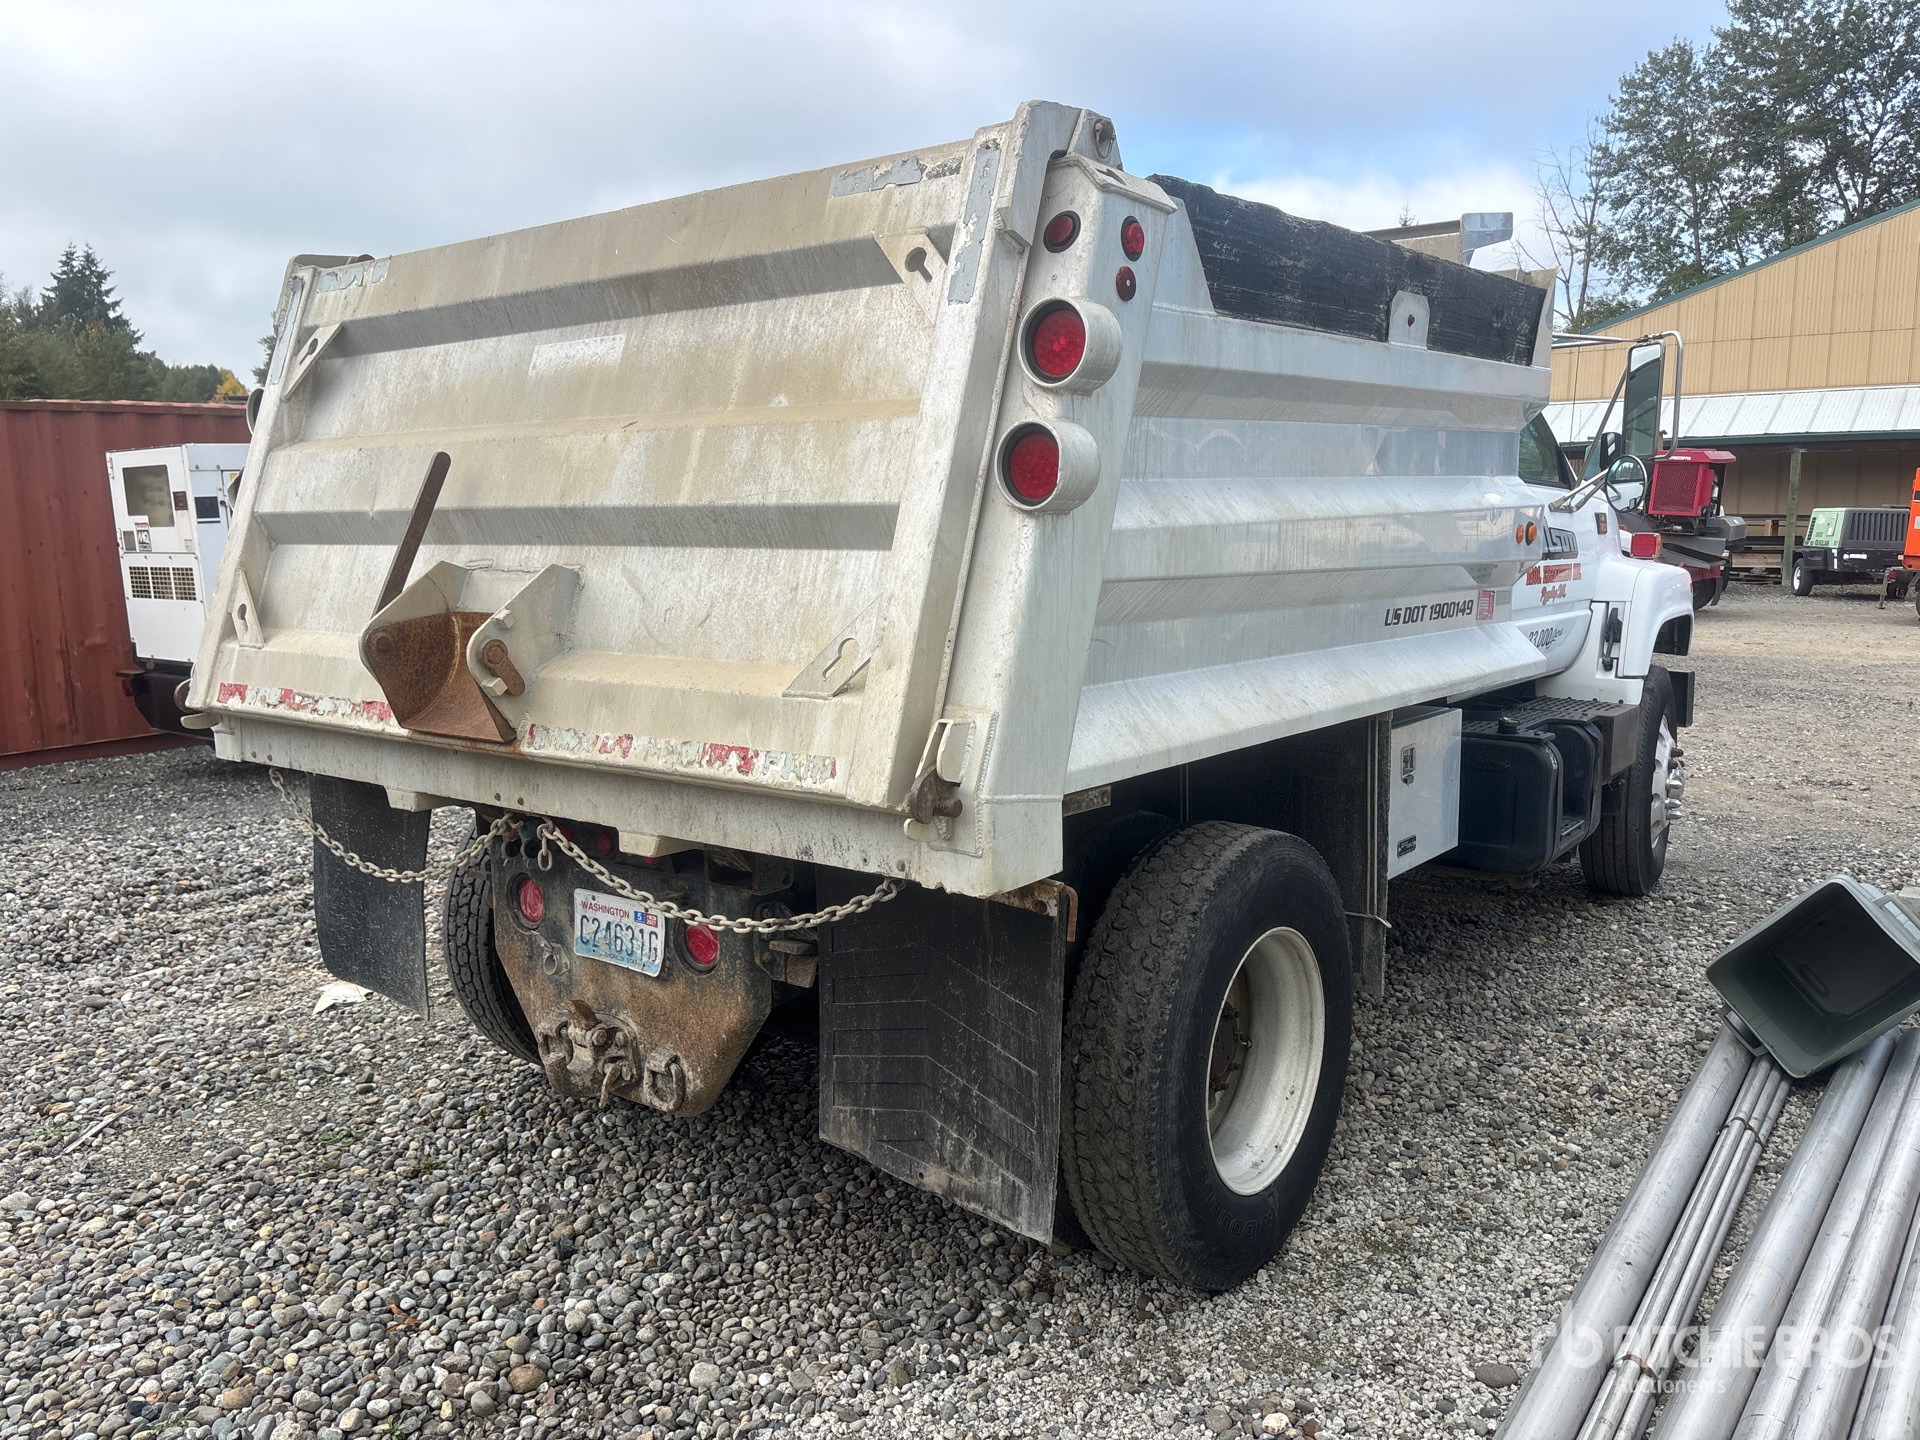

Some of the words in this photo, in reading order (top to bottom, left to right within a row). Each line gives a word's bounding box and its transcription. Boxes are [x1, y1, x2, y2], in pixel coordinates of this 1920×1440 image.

[1384, 607, 1402, 627] US
[1402, 605, 1428, 624] DOT
[1429, 600, 1474, 620] 1900149
[581, 900, 630, 919] WASHINGTON
[637, 912, 643, 921] 5
